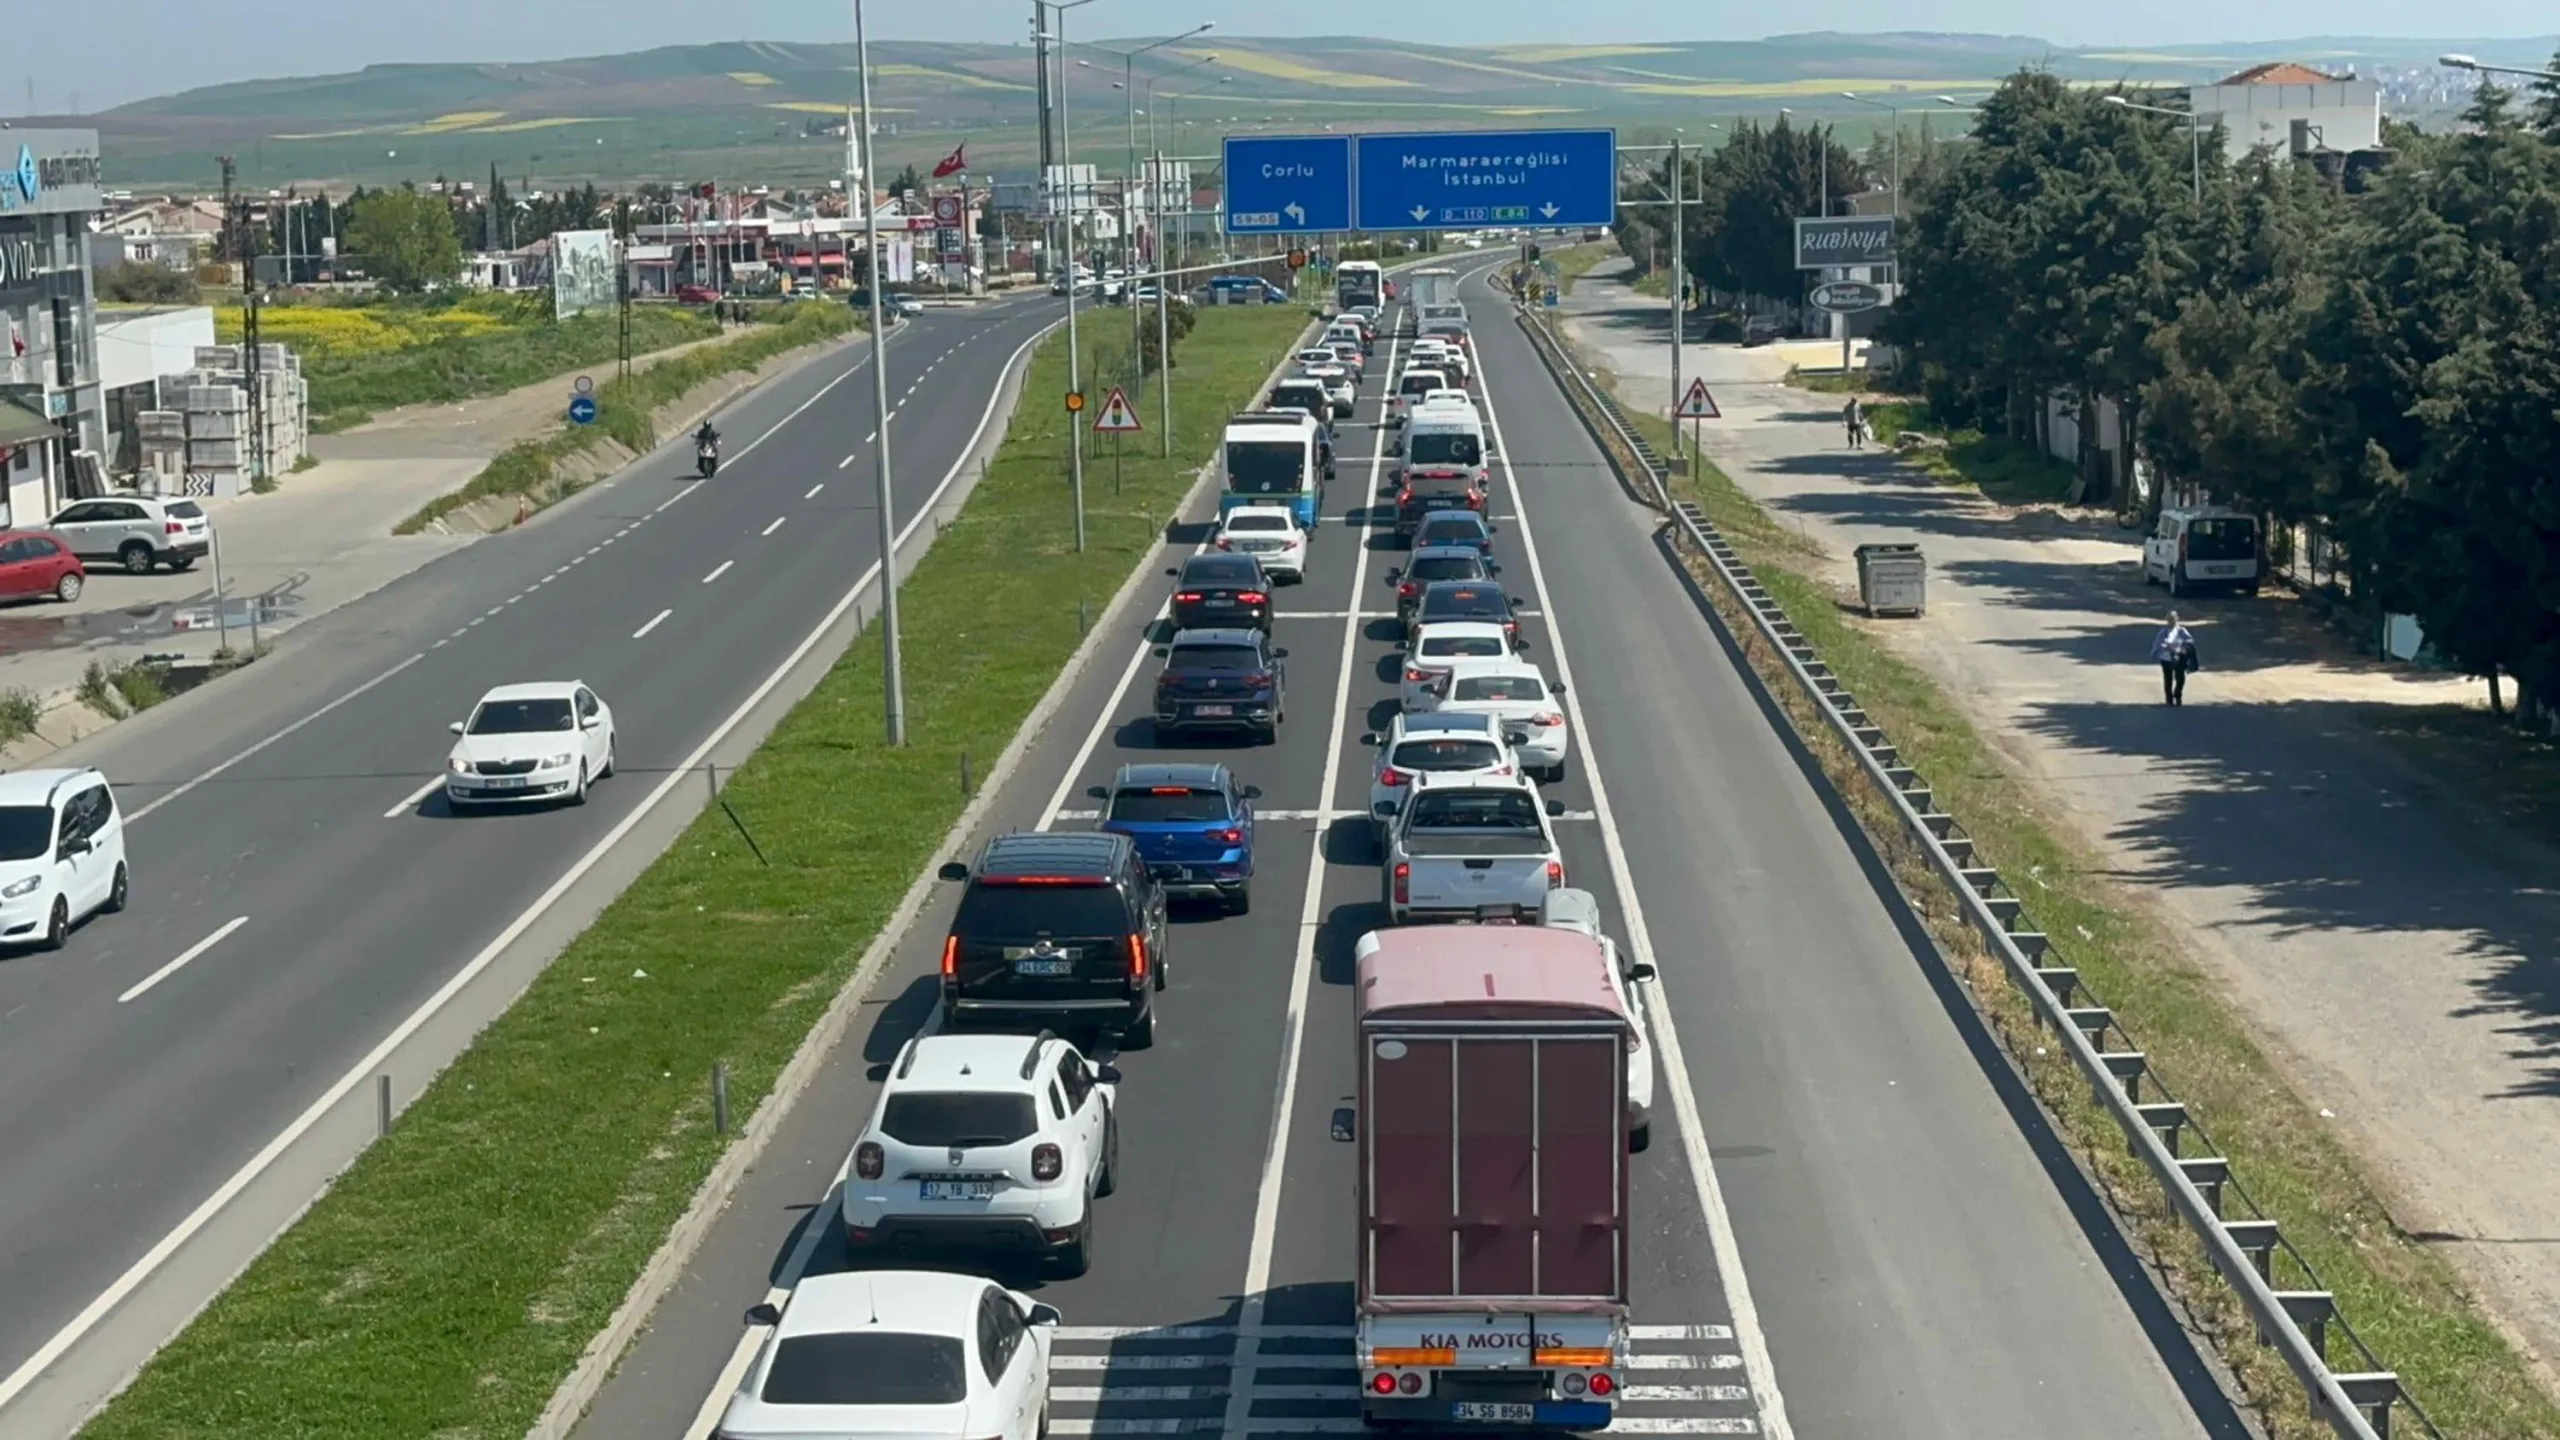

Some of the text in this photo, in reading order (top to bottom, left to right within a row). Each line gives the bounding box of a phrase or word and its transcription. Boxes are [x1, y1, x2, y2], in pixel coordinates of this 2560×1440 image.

[1261, 164, 1315, 178] Çorlu
[1444, 170, 1526, 186] İstanbul
[1803, 228, 1888, 252] RUBİNYA
[1420, 1333, 1563, 1349] KIA MOTORS
[1459, 1404, 1474, 1417] 34
